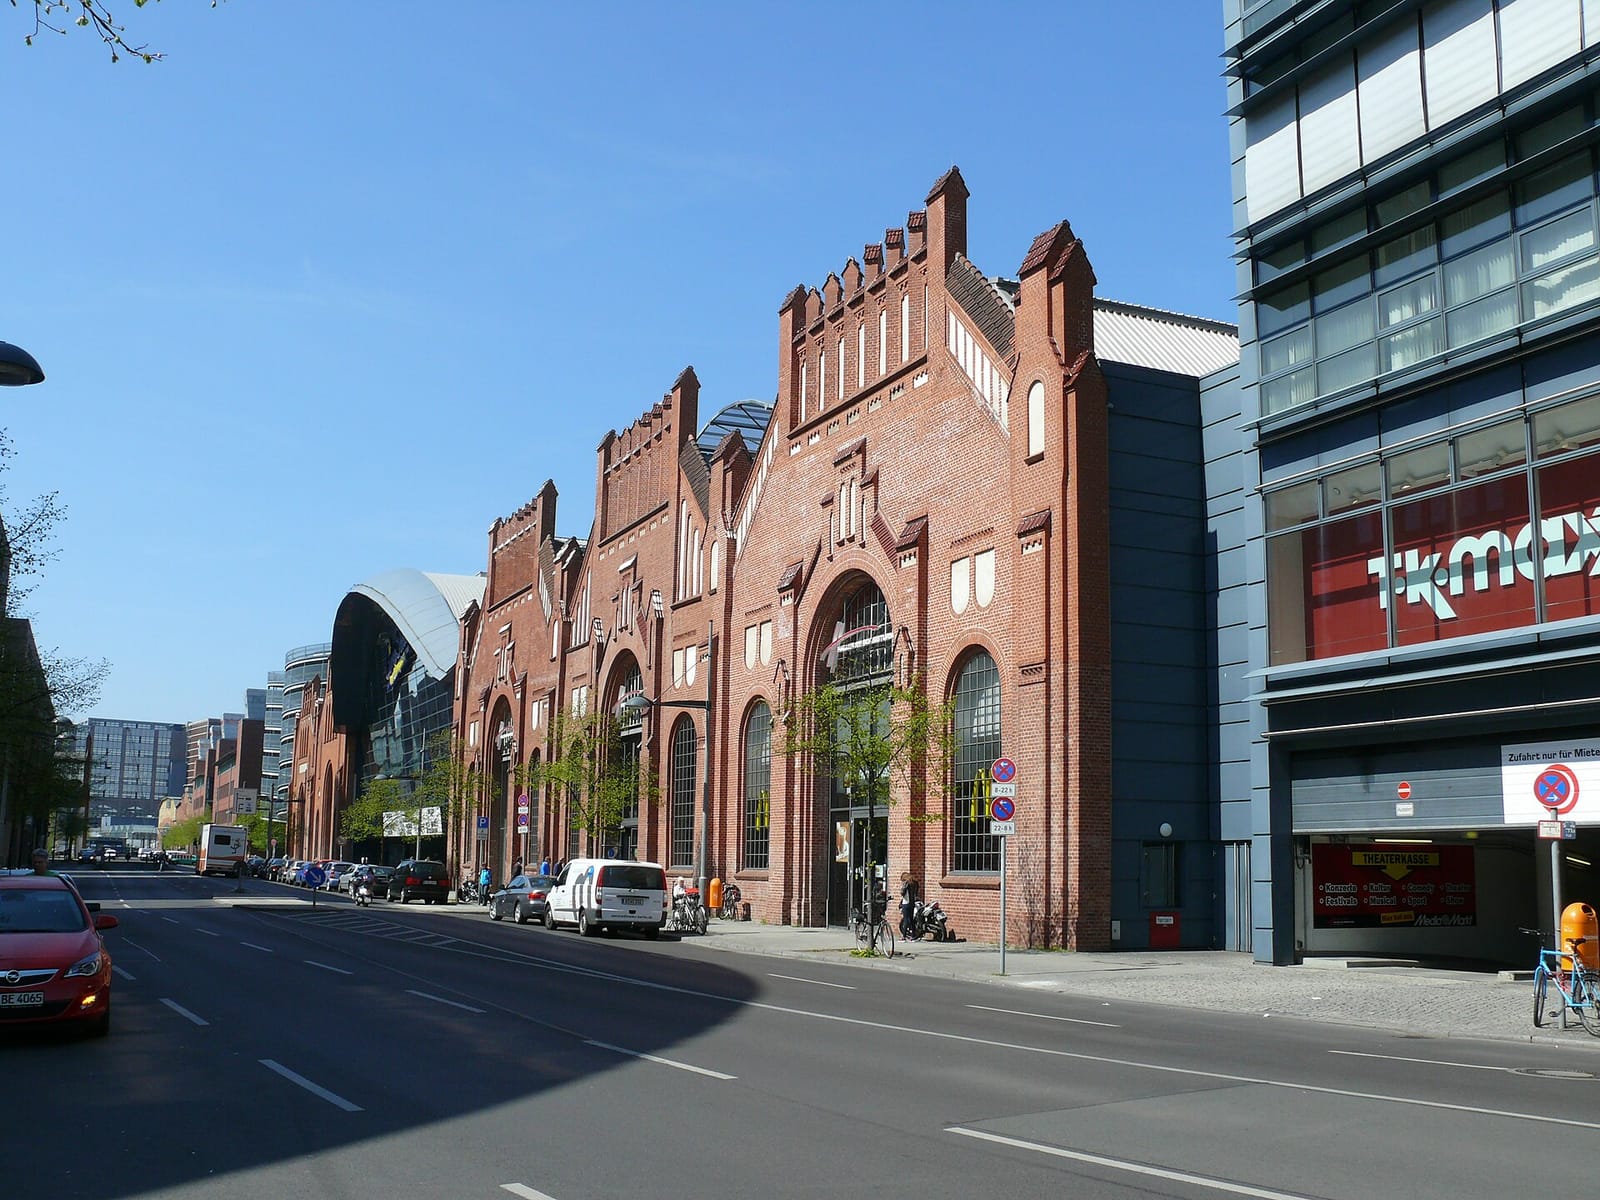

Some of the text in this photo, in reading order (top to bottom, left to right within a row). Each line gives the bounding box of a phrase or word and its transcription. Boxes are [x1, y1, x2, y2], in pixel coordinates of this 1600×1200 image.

[1508, 752, 1540, 762] Zufahrt
[1542, 752, 1557, 760] nur
[1559, 749, 1572, 759] für
[479, 818, 487, 827] P
[1362, 853, 1429, 865] THEATERKASSE
[1325, 883, 1358, 893] Konzerte
[1325, 896, 1358, 906] Festivals
[1369, 896, 1397, 906] Musical
[1, 993, 42, 1004] BE 4065
